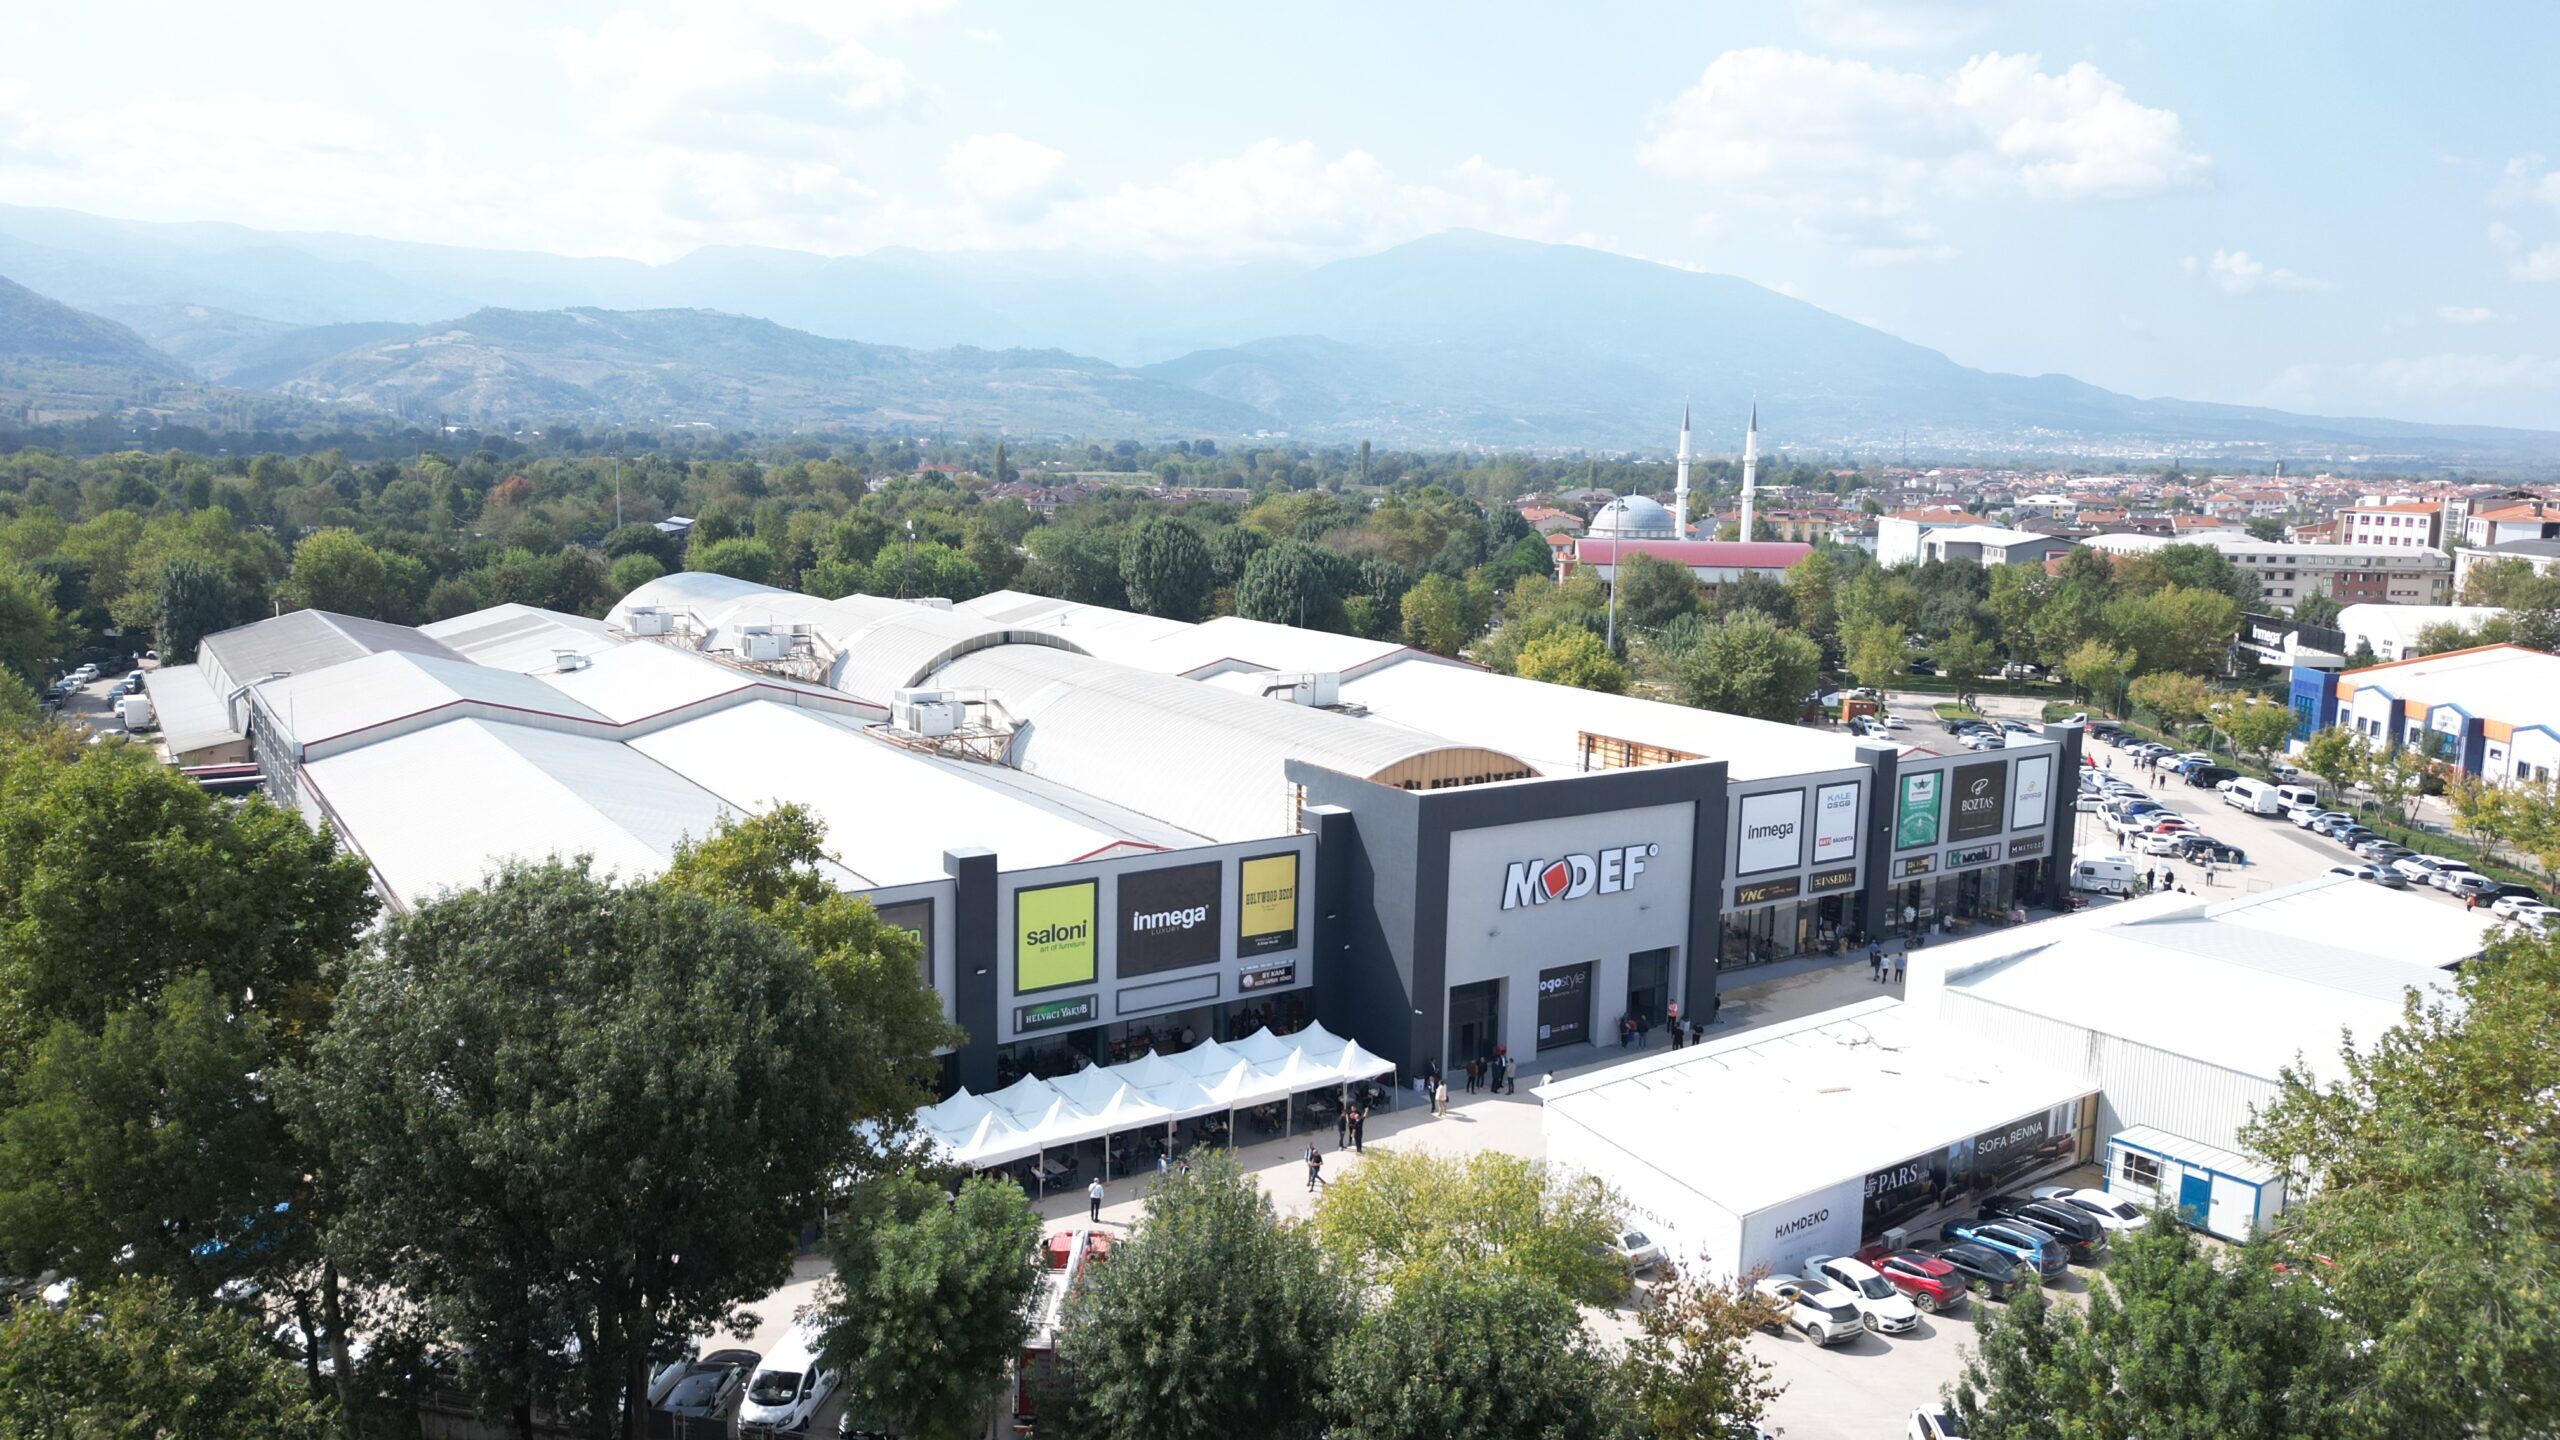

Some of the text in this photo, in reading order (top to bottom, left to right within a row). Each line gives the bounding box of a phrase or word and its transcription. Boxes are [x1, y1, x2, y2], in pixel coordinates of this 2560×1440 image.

[1827, 791, 1850, 802] KALE
[1748, 822, 1795, 840] inmega
[1740, 887, 1767, 903] YNC
[1133, 906, 1206, 932] inmega
[1026, 919, 1087, 946] saloni
[1060, 1003, 1088, 1018] YAKUB
[1977, 1121, 2043, 1155] SOFA BENNA
[1878, 1163, 1918, 1194] PARS
[1775, 1208, 1829, 1239] HAMDEKO
